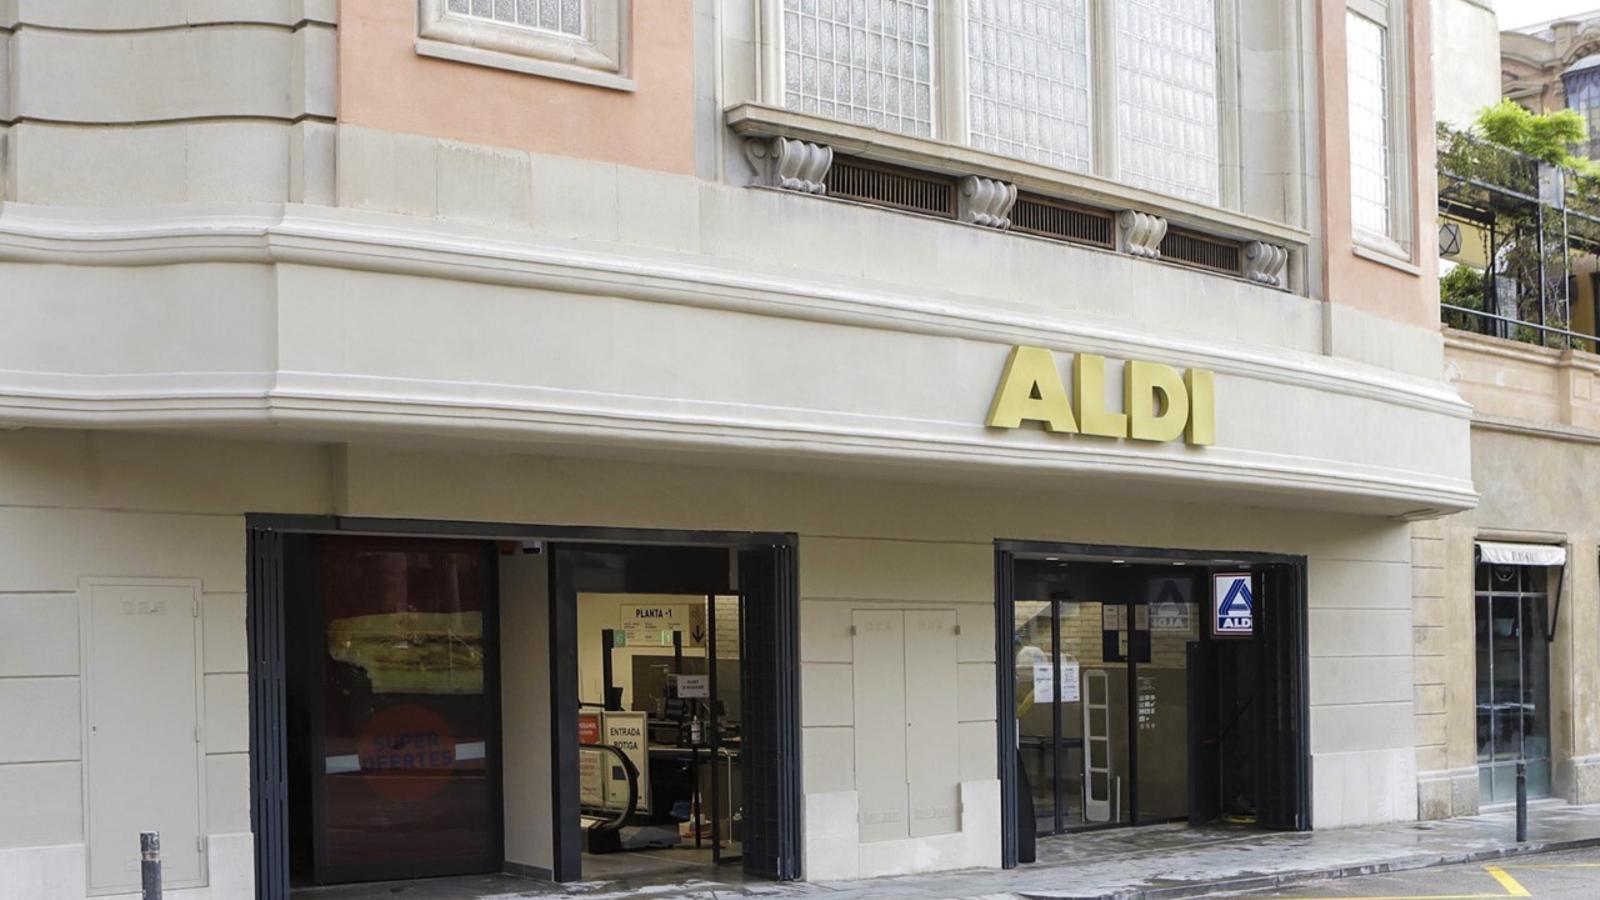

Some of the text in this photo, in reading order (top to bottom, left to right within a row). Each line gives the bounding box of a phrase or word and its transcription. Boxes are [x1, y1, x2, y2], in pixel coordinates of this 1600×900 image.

[985, 344, 1216, 447] ALDI
[635, 608, 663, 618] PLANTA
[1222, 617, 1252, 628] ALD
[610, 727, 641, 736] ENTRADA
[372, 731, 440, 751] SUPER
[361, 749, 454, 772] OFERTES
